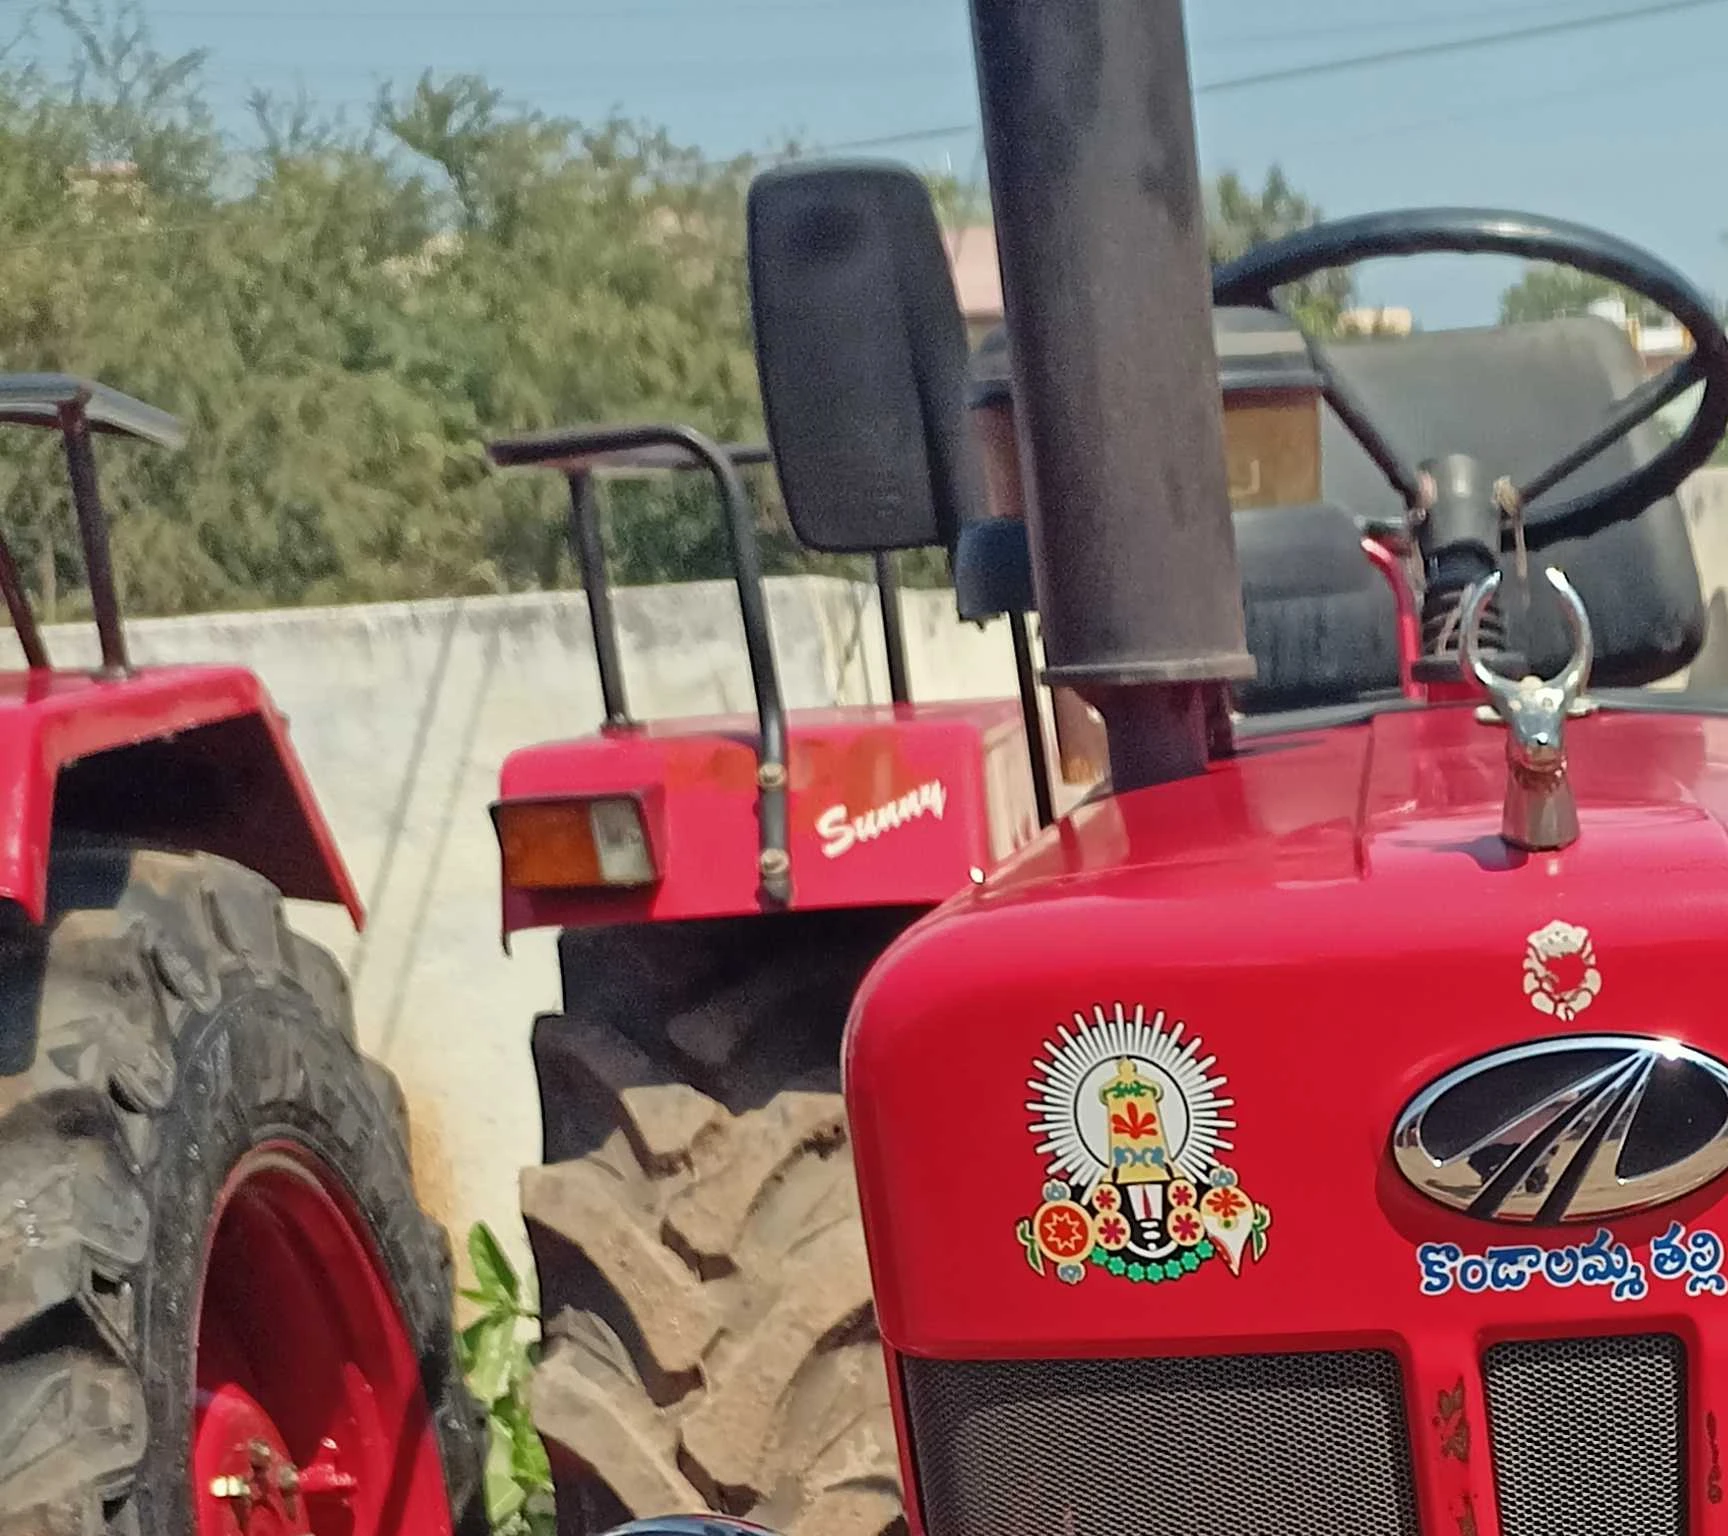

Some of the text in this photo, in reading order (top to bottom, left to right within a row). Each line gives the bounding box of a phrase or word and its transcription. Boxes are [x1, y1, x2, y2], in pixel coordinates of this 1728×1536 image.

[816, 779, 947, 858] Sunny
[1417, 1221, 1728, 1301] కొండాలమ్మ తల్లి
